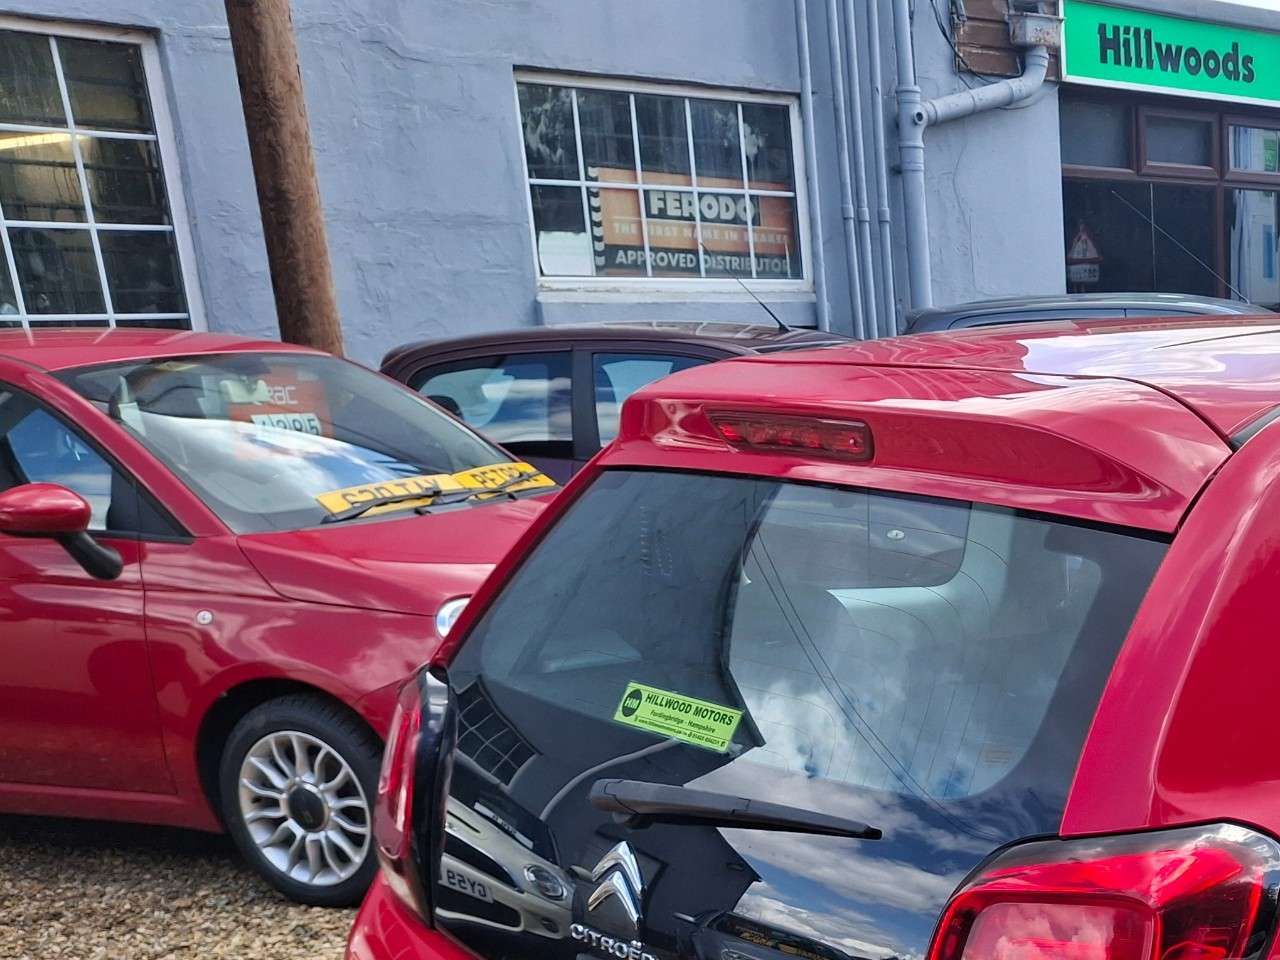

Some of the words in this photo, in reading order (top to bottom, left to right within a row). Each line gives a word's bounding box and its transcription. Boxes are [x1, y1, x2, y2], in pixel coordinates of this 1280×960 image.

[1097, 22, 1255, 83] Hillwoods
[650, 190, 756, 222] FERODO
[613, 222, 638, 235] THE
[645, 223, 680, 239] IRST
[682, 225, 721, 241] NAME
[723, 228, 738, 242] IN
[616, 249, 697, 269] APPROVED
[645, 693, 693, 714] HILLWOOD
[693, 706, 735, 726] MOTORS
[688, 720, 716, 734] Hampshire
